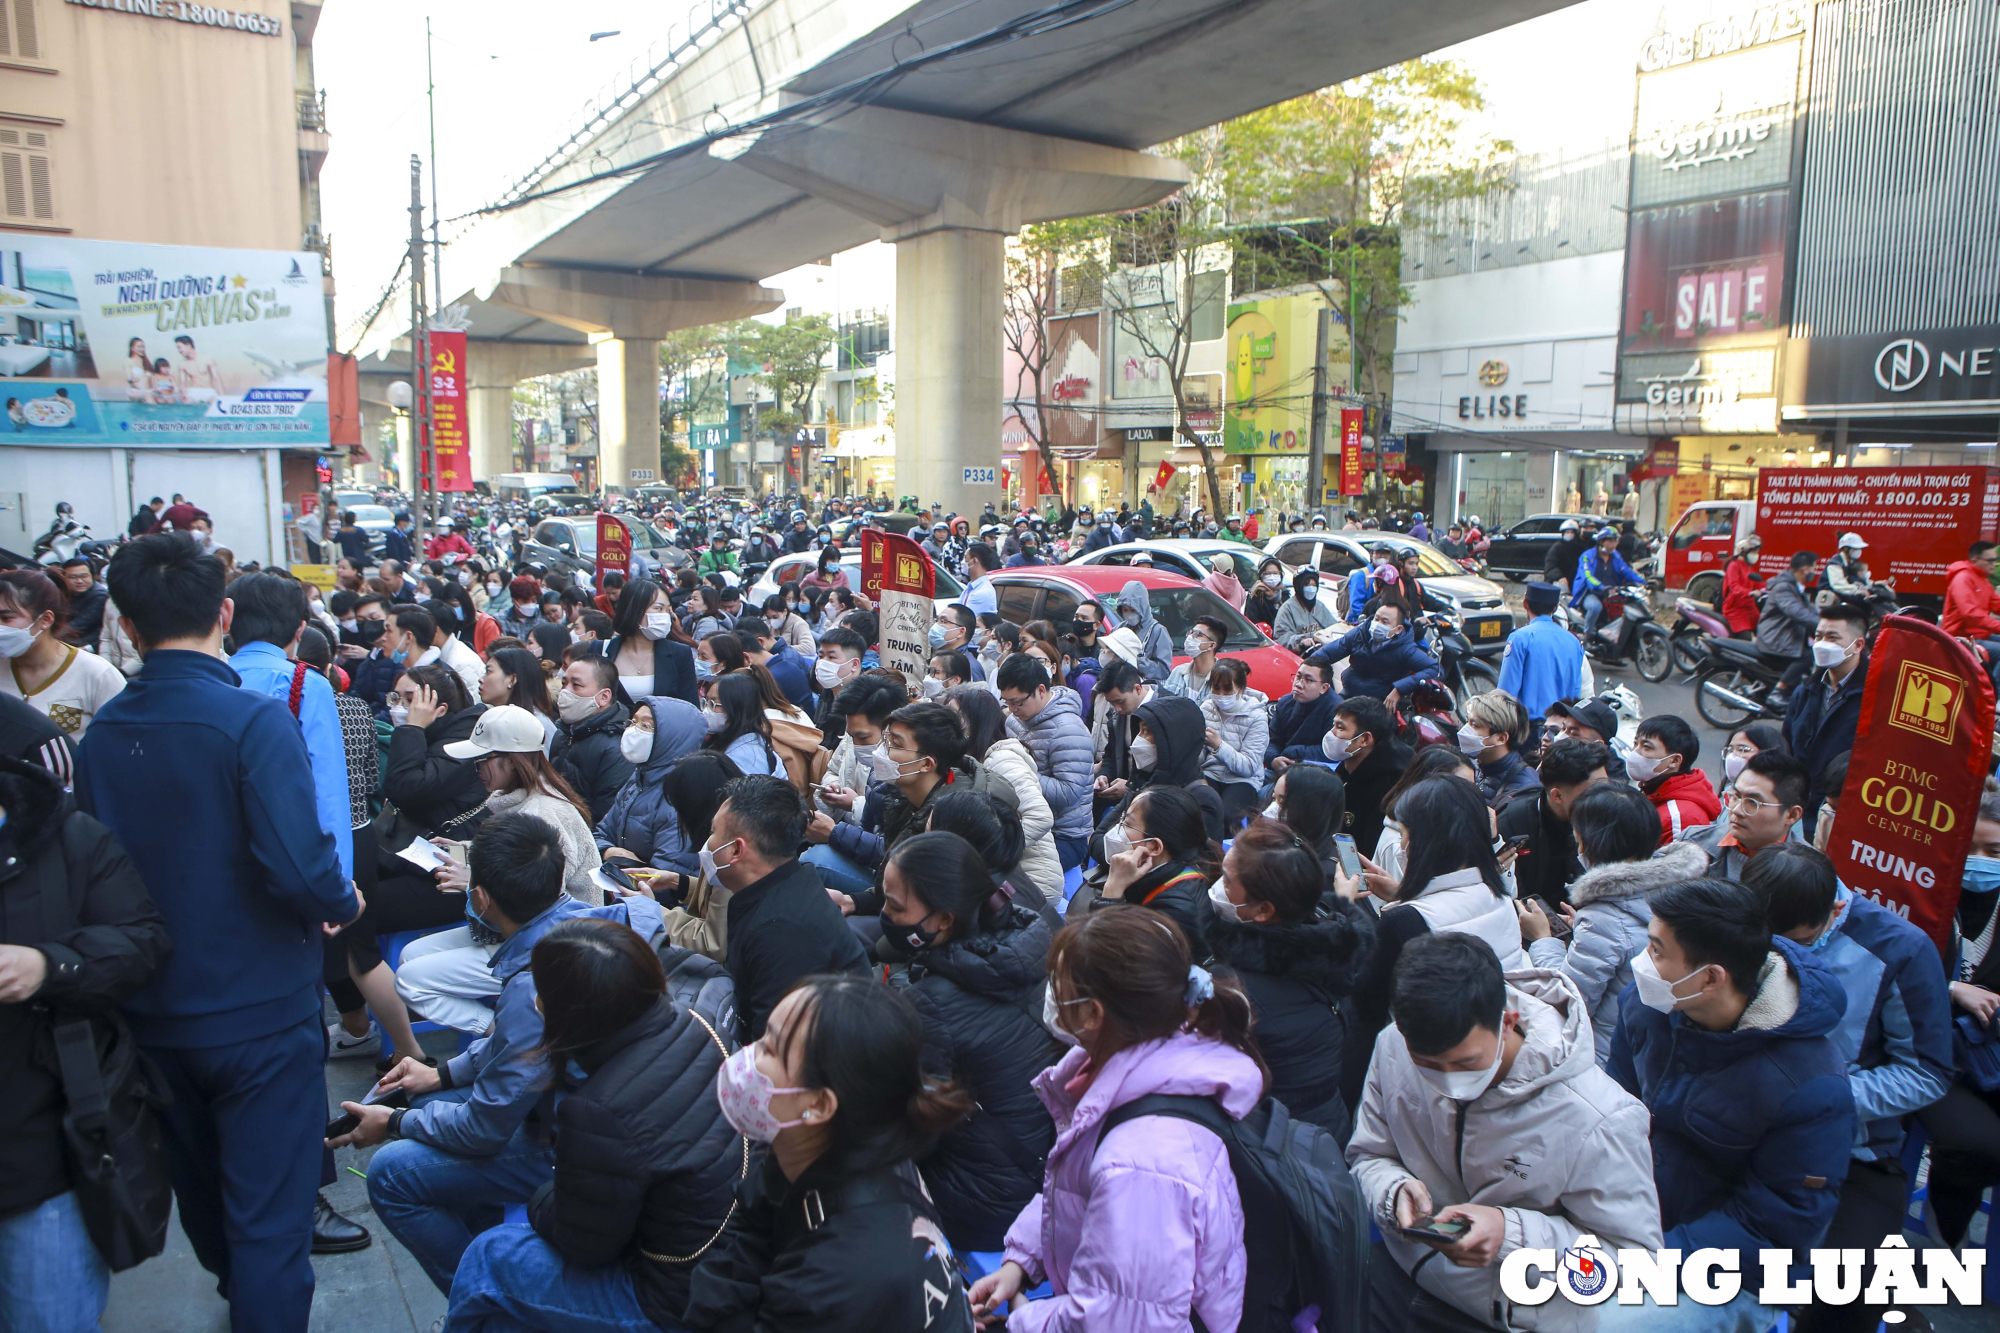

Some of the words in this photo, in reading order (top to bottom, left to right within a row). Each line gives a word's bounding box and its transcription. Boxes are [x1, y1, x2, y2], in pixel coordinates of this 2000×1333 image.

[65, 0, 174, 18] OTLINE:
[178, 3, 230, 28] 1800
[233, 12, 282, 36] 6657
[216, 275, 227, 293] 4
[157, 288, 262, 333] CANVAS
[1676, 274, 1766, 331] SALE
[1255, 344, 1270, 353] KIDS
[1938, 347, 2000, 378] NE
[1458, 393, 1528, 419] ELISE
[1128, 429, 1154, 441] LALYA
[1235, 423, 1264, 450] BẮP
[631, 469, 653, 480] P333
[964, 468, 995, 483] P334
[1767, 475, 1786, 487] TAXI
[1813, 491, 1837, 505] DUY
[1874, 491, 1971, 507] 1800.00.33
[601, 552, 627, 561] GOLD
[901, 600, 922, 611] BTMC
[897, 624, 918, 633] CENTER
[887, 638, 923, 655] TRUNG
[890, 659, 914, 674] TÂM
[1899, 712, 1923, 726] BTMC
[1925, 721, 1946, 734] 1989
[1884, 759, 1938, 791] BTMC
[1861, 777, 1956, 833] GOLD
[1867, 813, 1933, 846] CENTER
[1850, 839, 1936, 889] TRUNG
